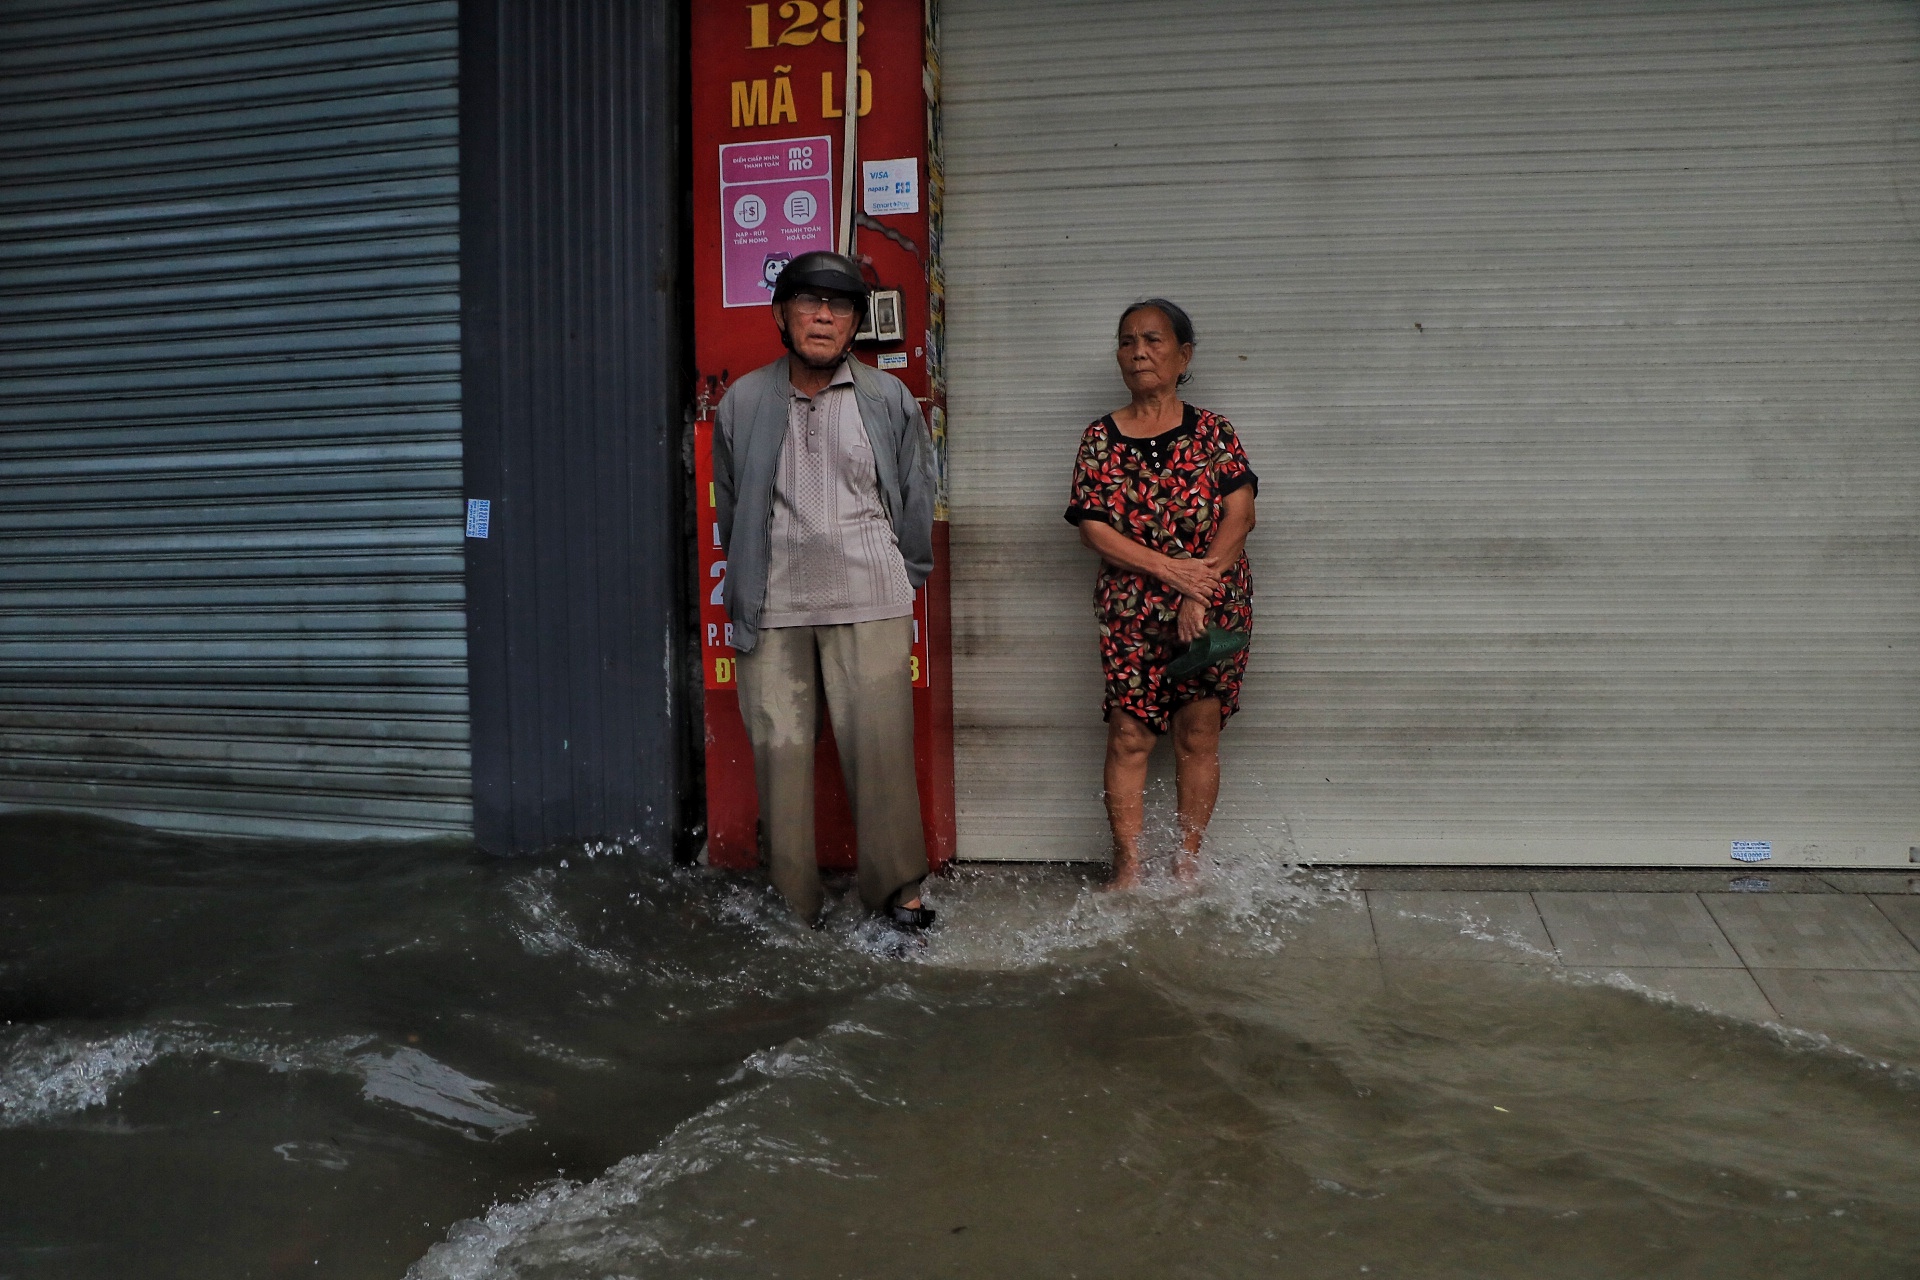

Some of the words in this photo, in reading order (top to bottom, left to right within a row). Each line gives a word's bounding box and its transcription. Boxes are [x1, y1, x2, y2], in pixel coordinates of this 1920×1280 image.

[745, 0, 865, 49] 128
[731, 65, 797, 127] MÃ
[870, 171, 888, 179] VISA
[753, 229, 766, 237] RÚT
[707, 623, 720, 646] P.
